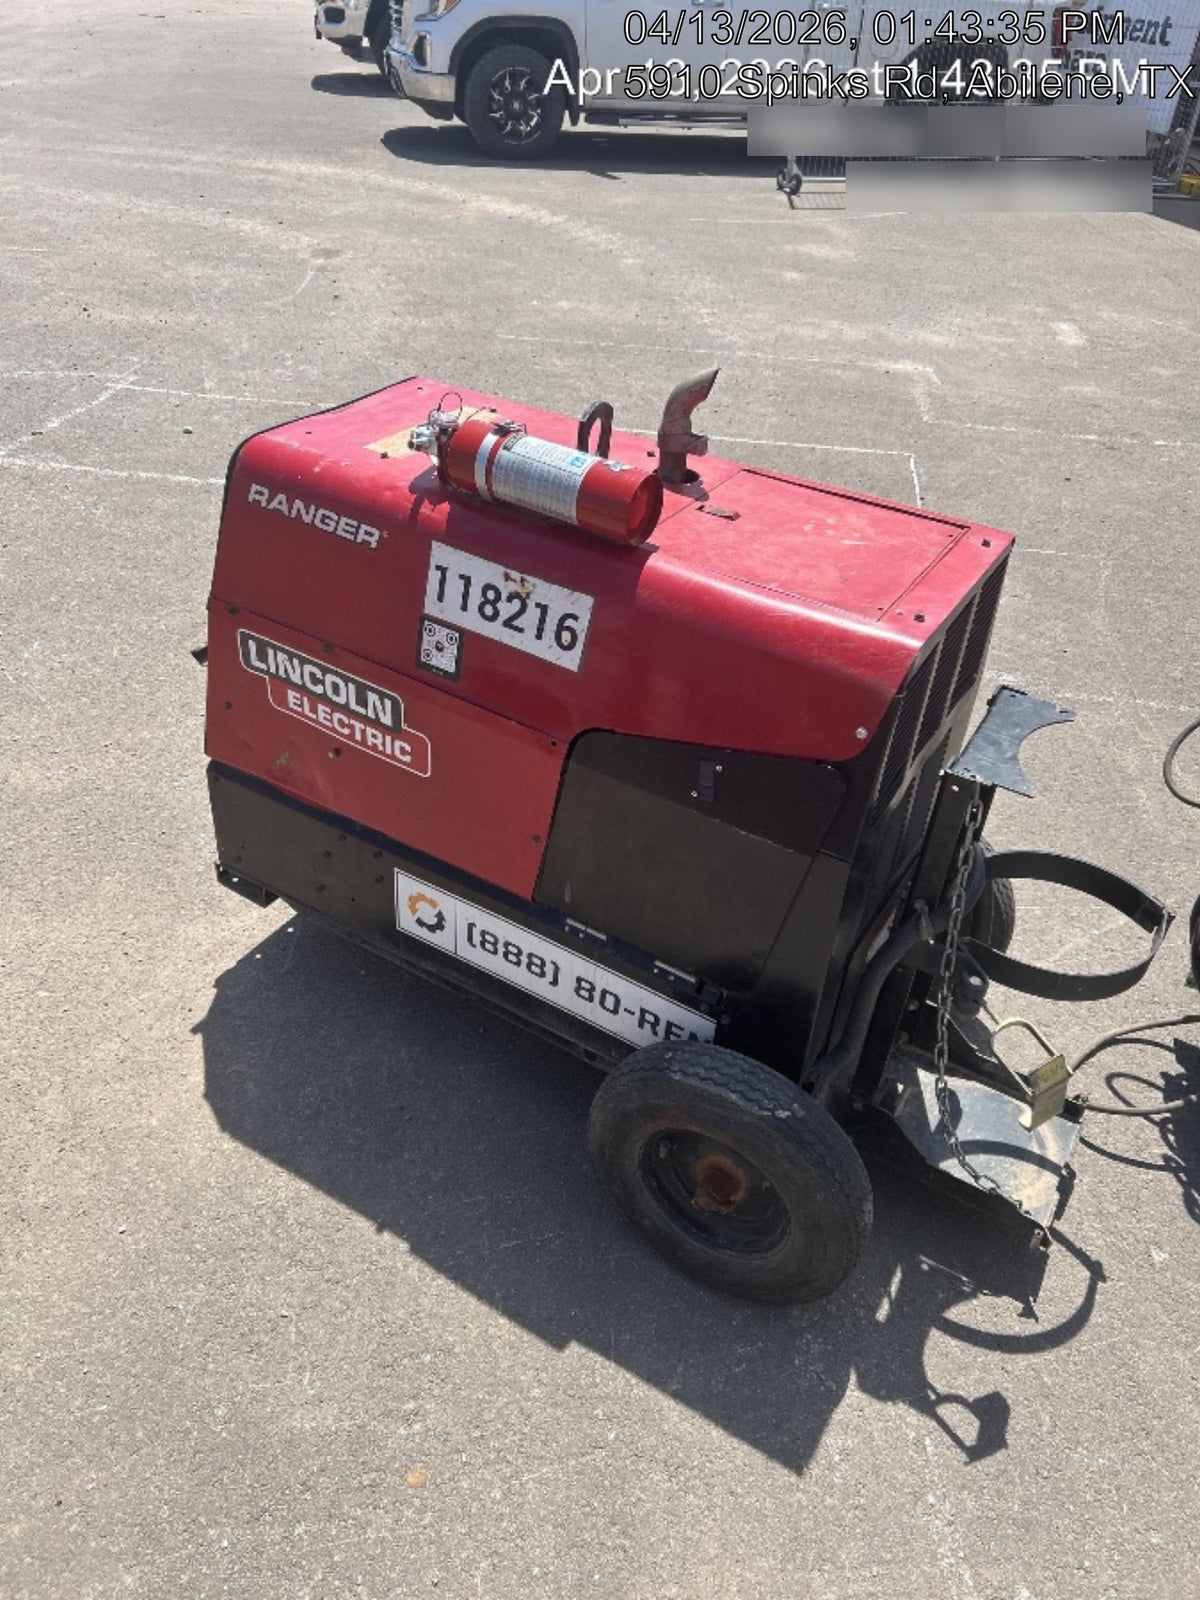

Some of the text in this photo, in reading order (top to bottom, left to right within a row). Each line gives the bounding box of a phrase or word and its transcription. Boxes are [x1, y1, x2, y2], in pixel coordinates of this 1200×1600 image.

[248, 483, 380, 549] RANGER
[435, 564, 581, 652] 118216
[248, 639, 393, 727] LINCOLN
[287, 689, 412, 763] ELECTRIC
[465, 921, 712, 1044] (888) 80-RE
